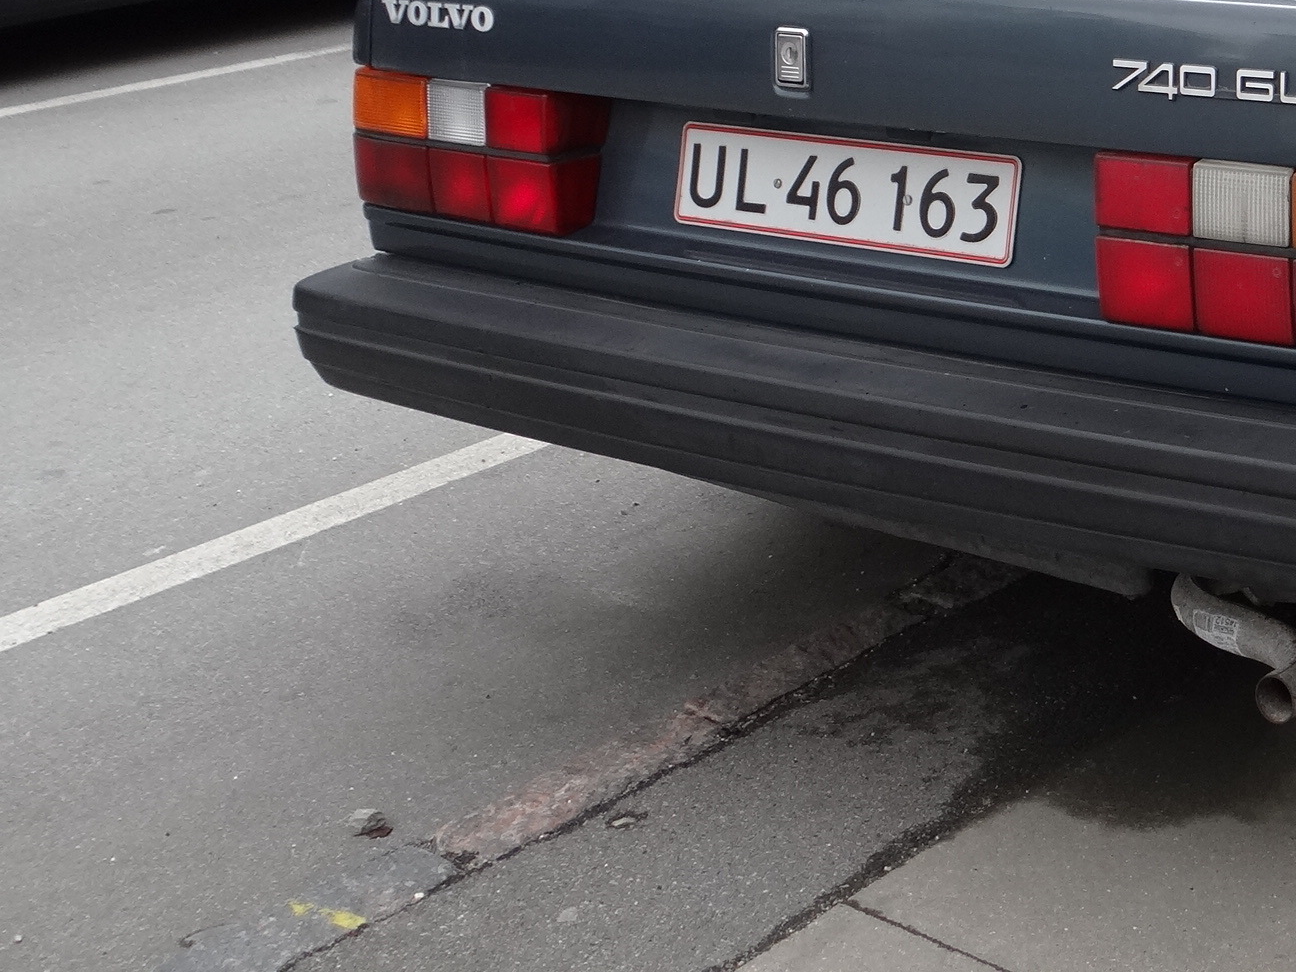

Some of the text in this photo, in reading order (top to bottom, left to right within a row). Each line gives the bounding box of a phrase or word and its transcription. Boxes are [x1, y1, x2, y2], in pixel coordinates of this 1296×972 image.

[1112, 57, 1217, 102] 740
[688, 142, 1000, 243] UL 46 163
